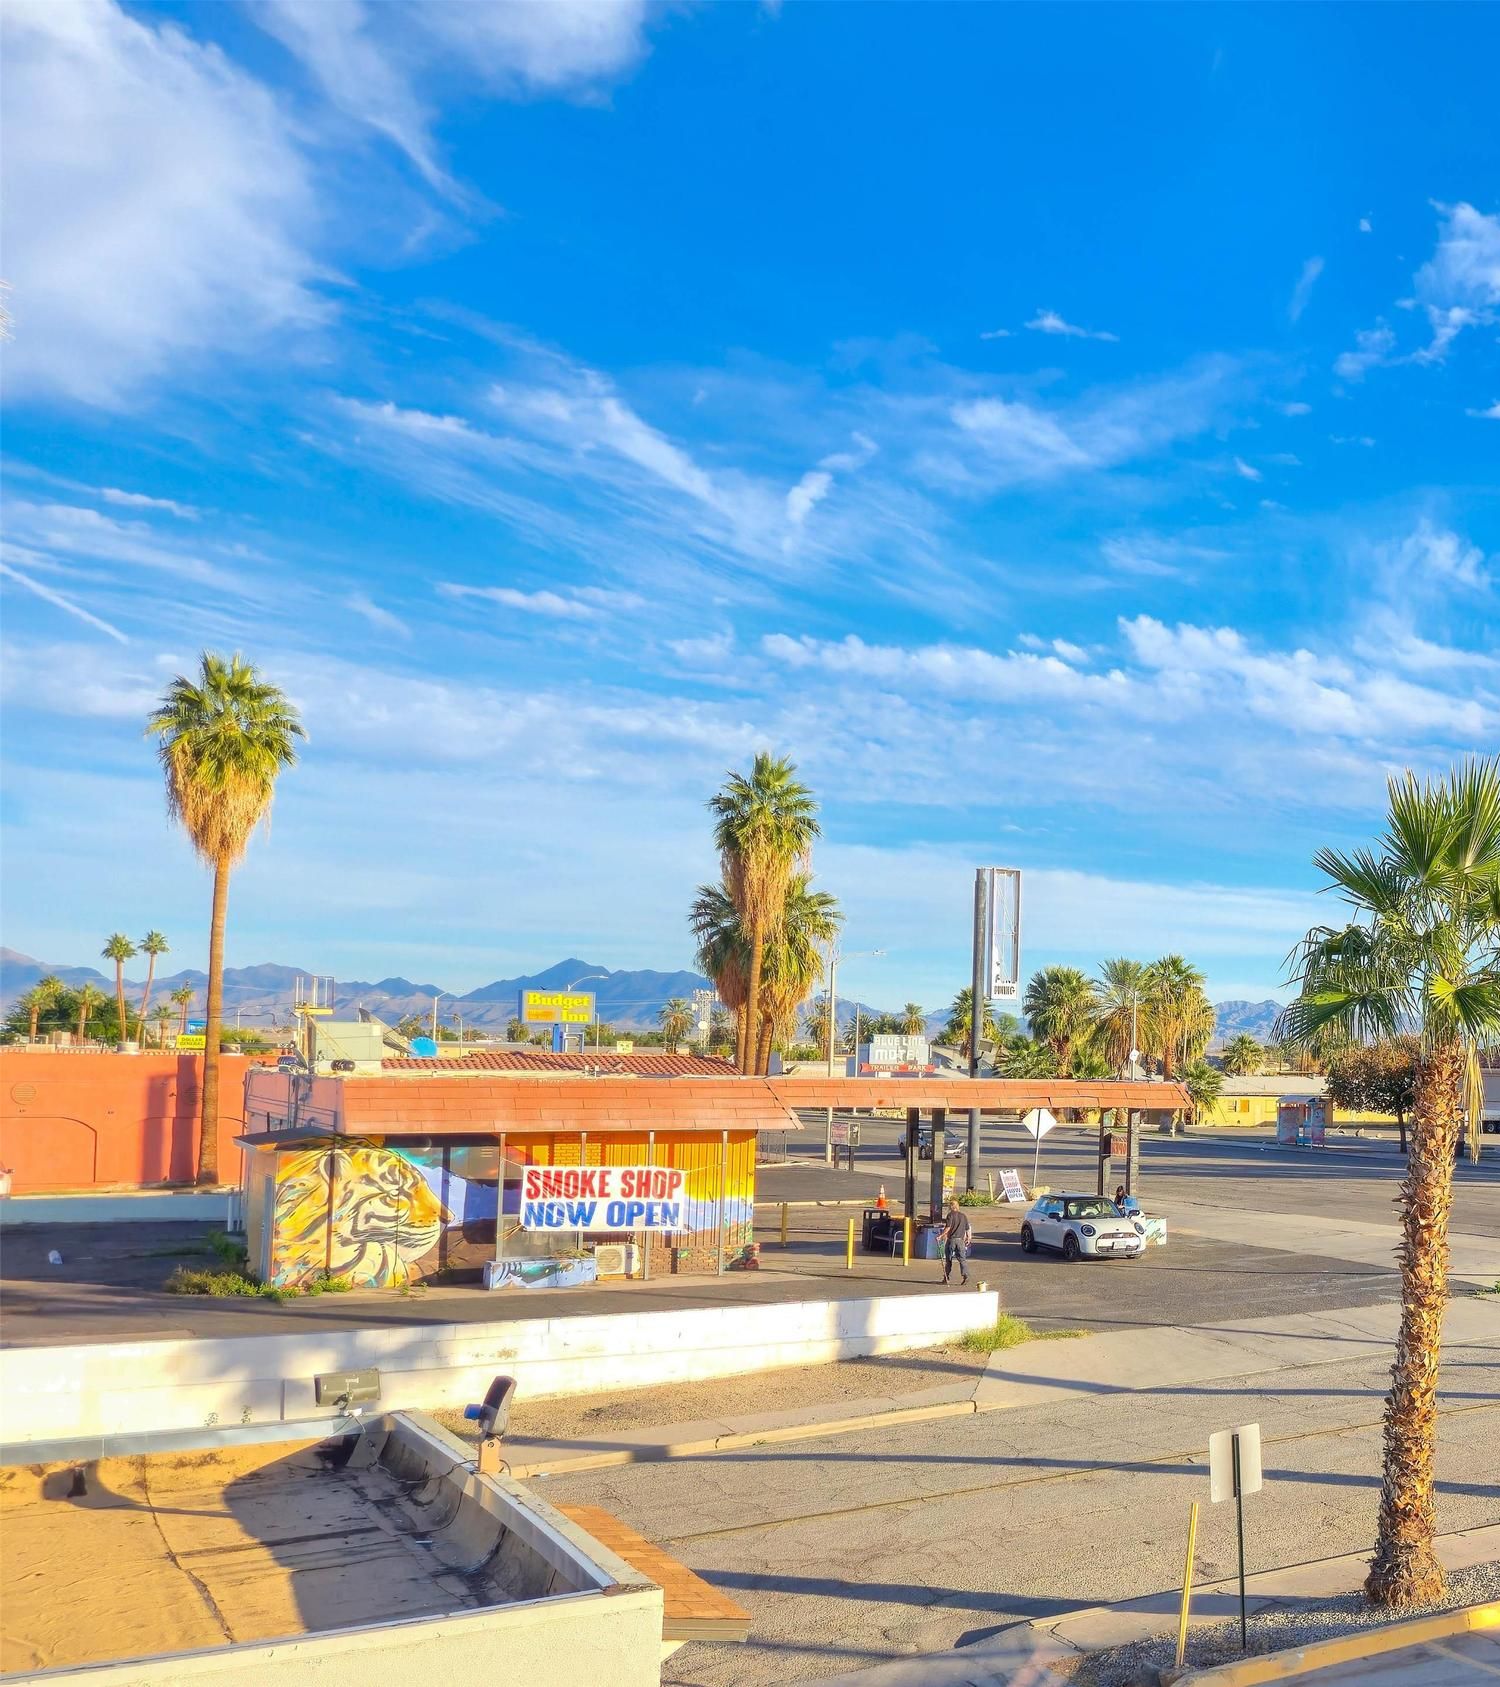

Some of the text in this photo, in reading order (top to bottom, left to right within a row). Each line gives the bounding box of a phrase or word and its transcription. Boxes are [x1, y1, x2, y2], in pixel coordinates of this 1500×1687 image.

[527, 992, 590, 1009] Budget
[561, 1009, 589, 1022] Inn
[874, 1035, 926, 1046] BLUE LINE
[874, 1049, 920, 1061] MOTEL
[525, 1169, 682, 1200] SMOKE SHOP
[524, 1201, 680, 1228] NOW OPEN
